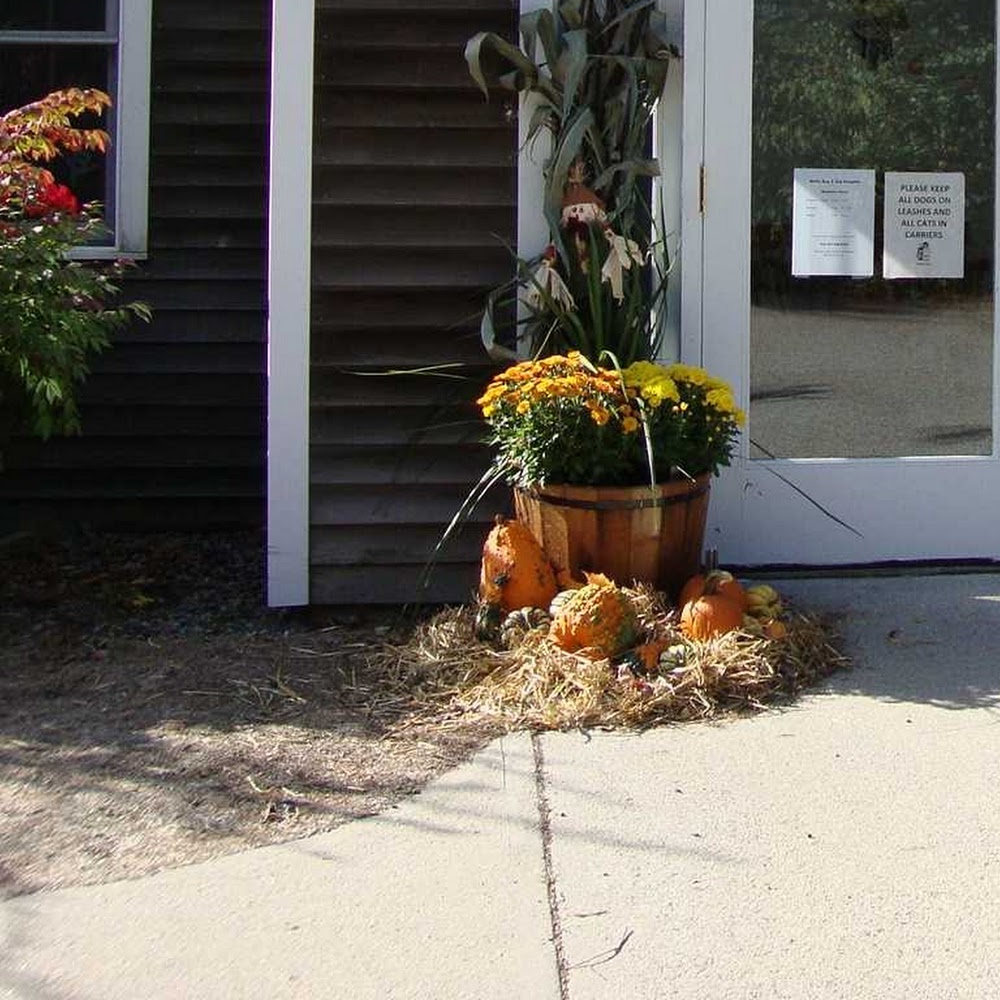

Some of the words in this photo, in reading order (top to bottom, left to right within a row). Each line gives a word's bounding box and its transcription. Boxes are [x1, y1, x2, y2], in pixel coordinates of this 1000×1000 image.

[900, 184, 927, 193] PLEASE
[930, 184, 950, 193] KEEP
[898, 196, 911, 204] ALL
[914, 196, 937, 204] DOGS
[898, 208, 931, 216] LEASHES
[933, 208, 951, 216] AND
[901, 219, 915, 227] ALL
[916, 219, 936, 227] CATS
[938, 220, 947, 228] IN
[905, 231, 943, 239] CARRIERS
